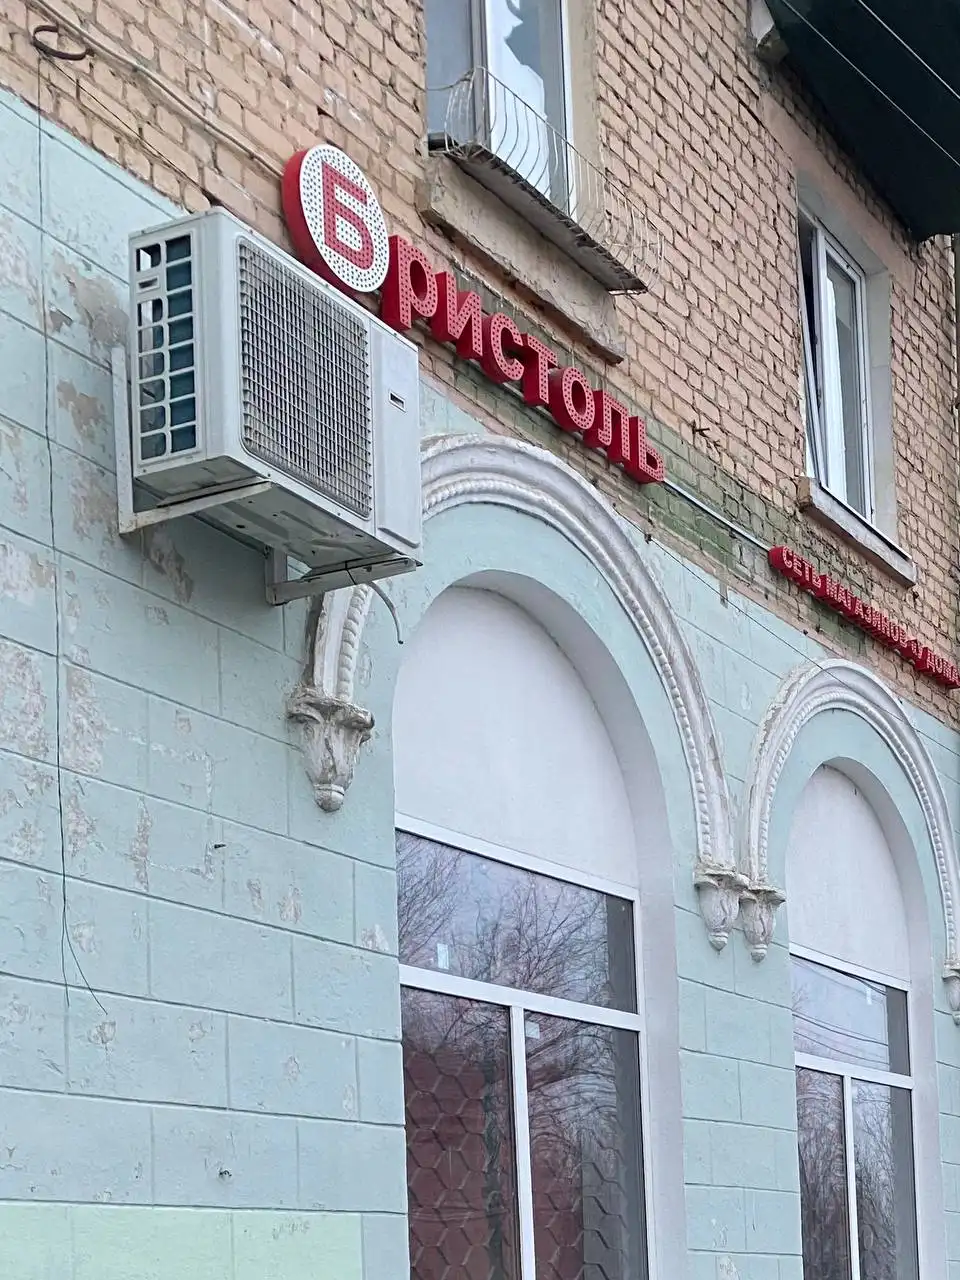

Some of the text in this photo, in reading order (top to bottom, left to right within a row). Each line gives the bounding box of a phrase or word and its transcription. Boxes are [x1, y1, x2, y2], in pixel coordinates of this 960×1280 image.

[298, 144, 665, 484] Бристоль
[776, 545, 822, 590] СЕТЬ
[824, 575, 908, 648] МАГАЗИНОВ
